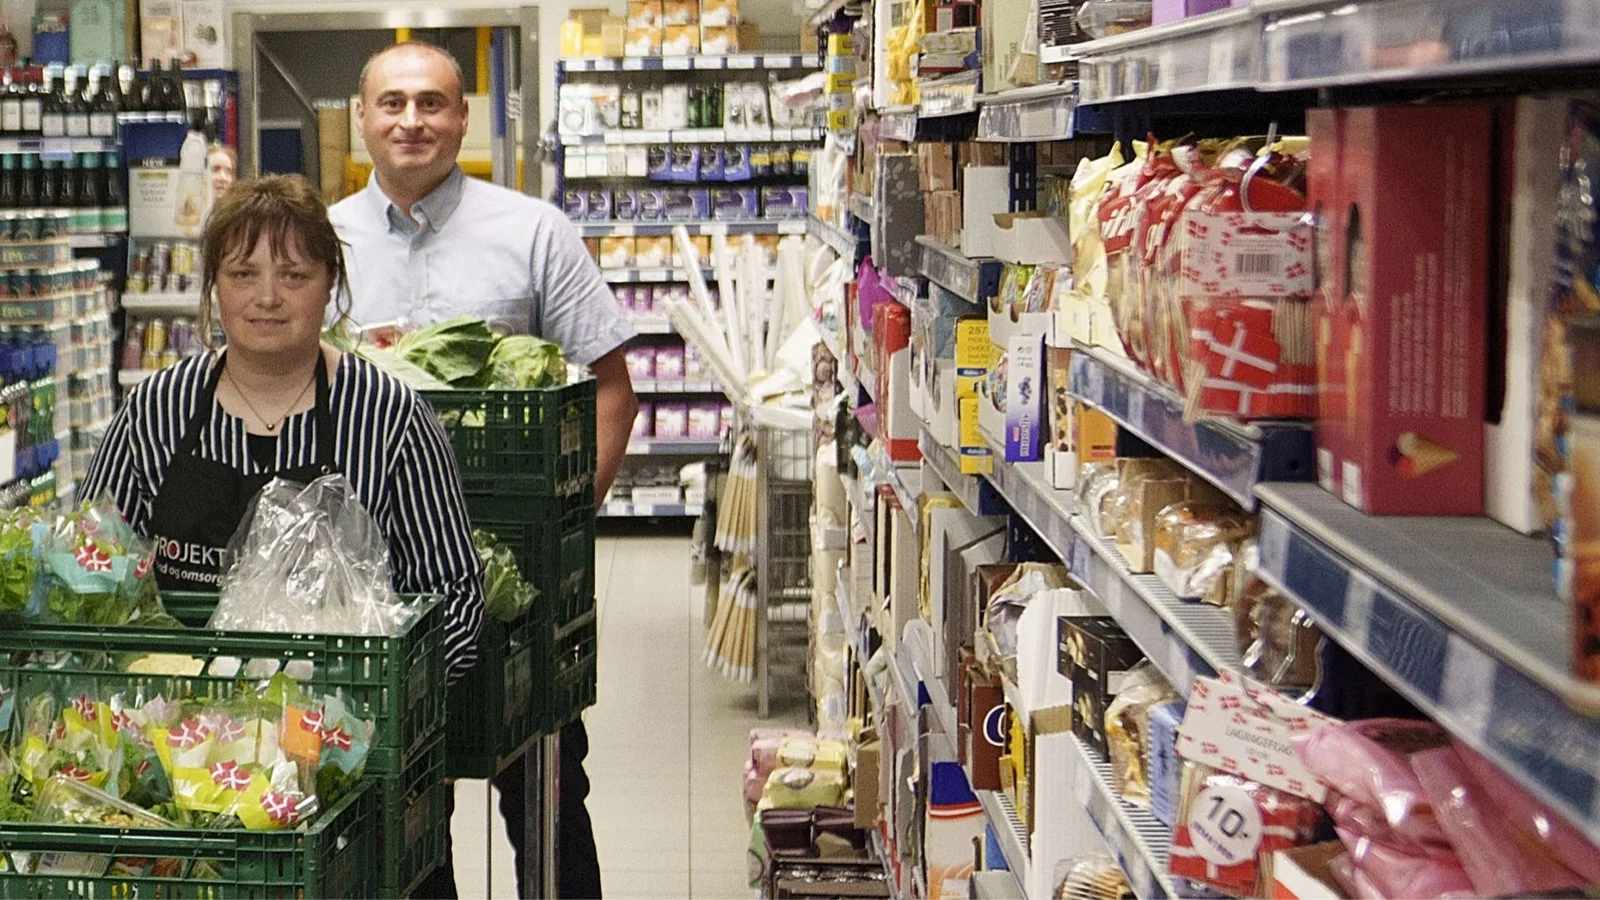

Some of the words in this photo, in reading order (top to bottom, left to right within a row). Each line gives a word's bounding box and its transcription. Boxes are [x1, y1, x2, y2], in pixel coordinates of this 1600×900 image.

[154, 535, 227, 566] PROJEKT
[169, 567, 180, 579] og
[181, 570, 224, 587] omsorg
